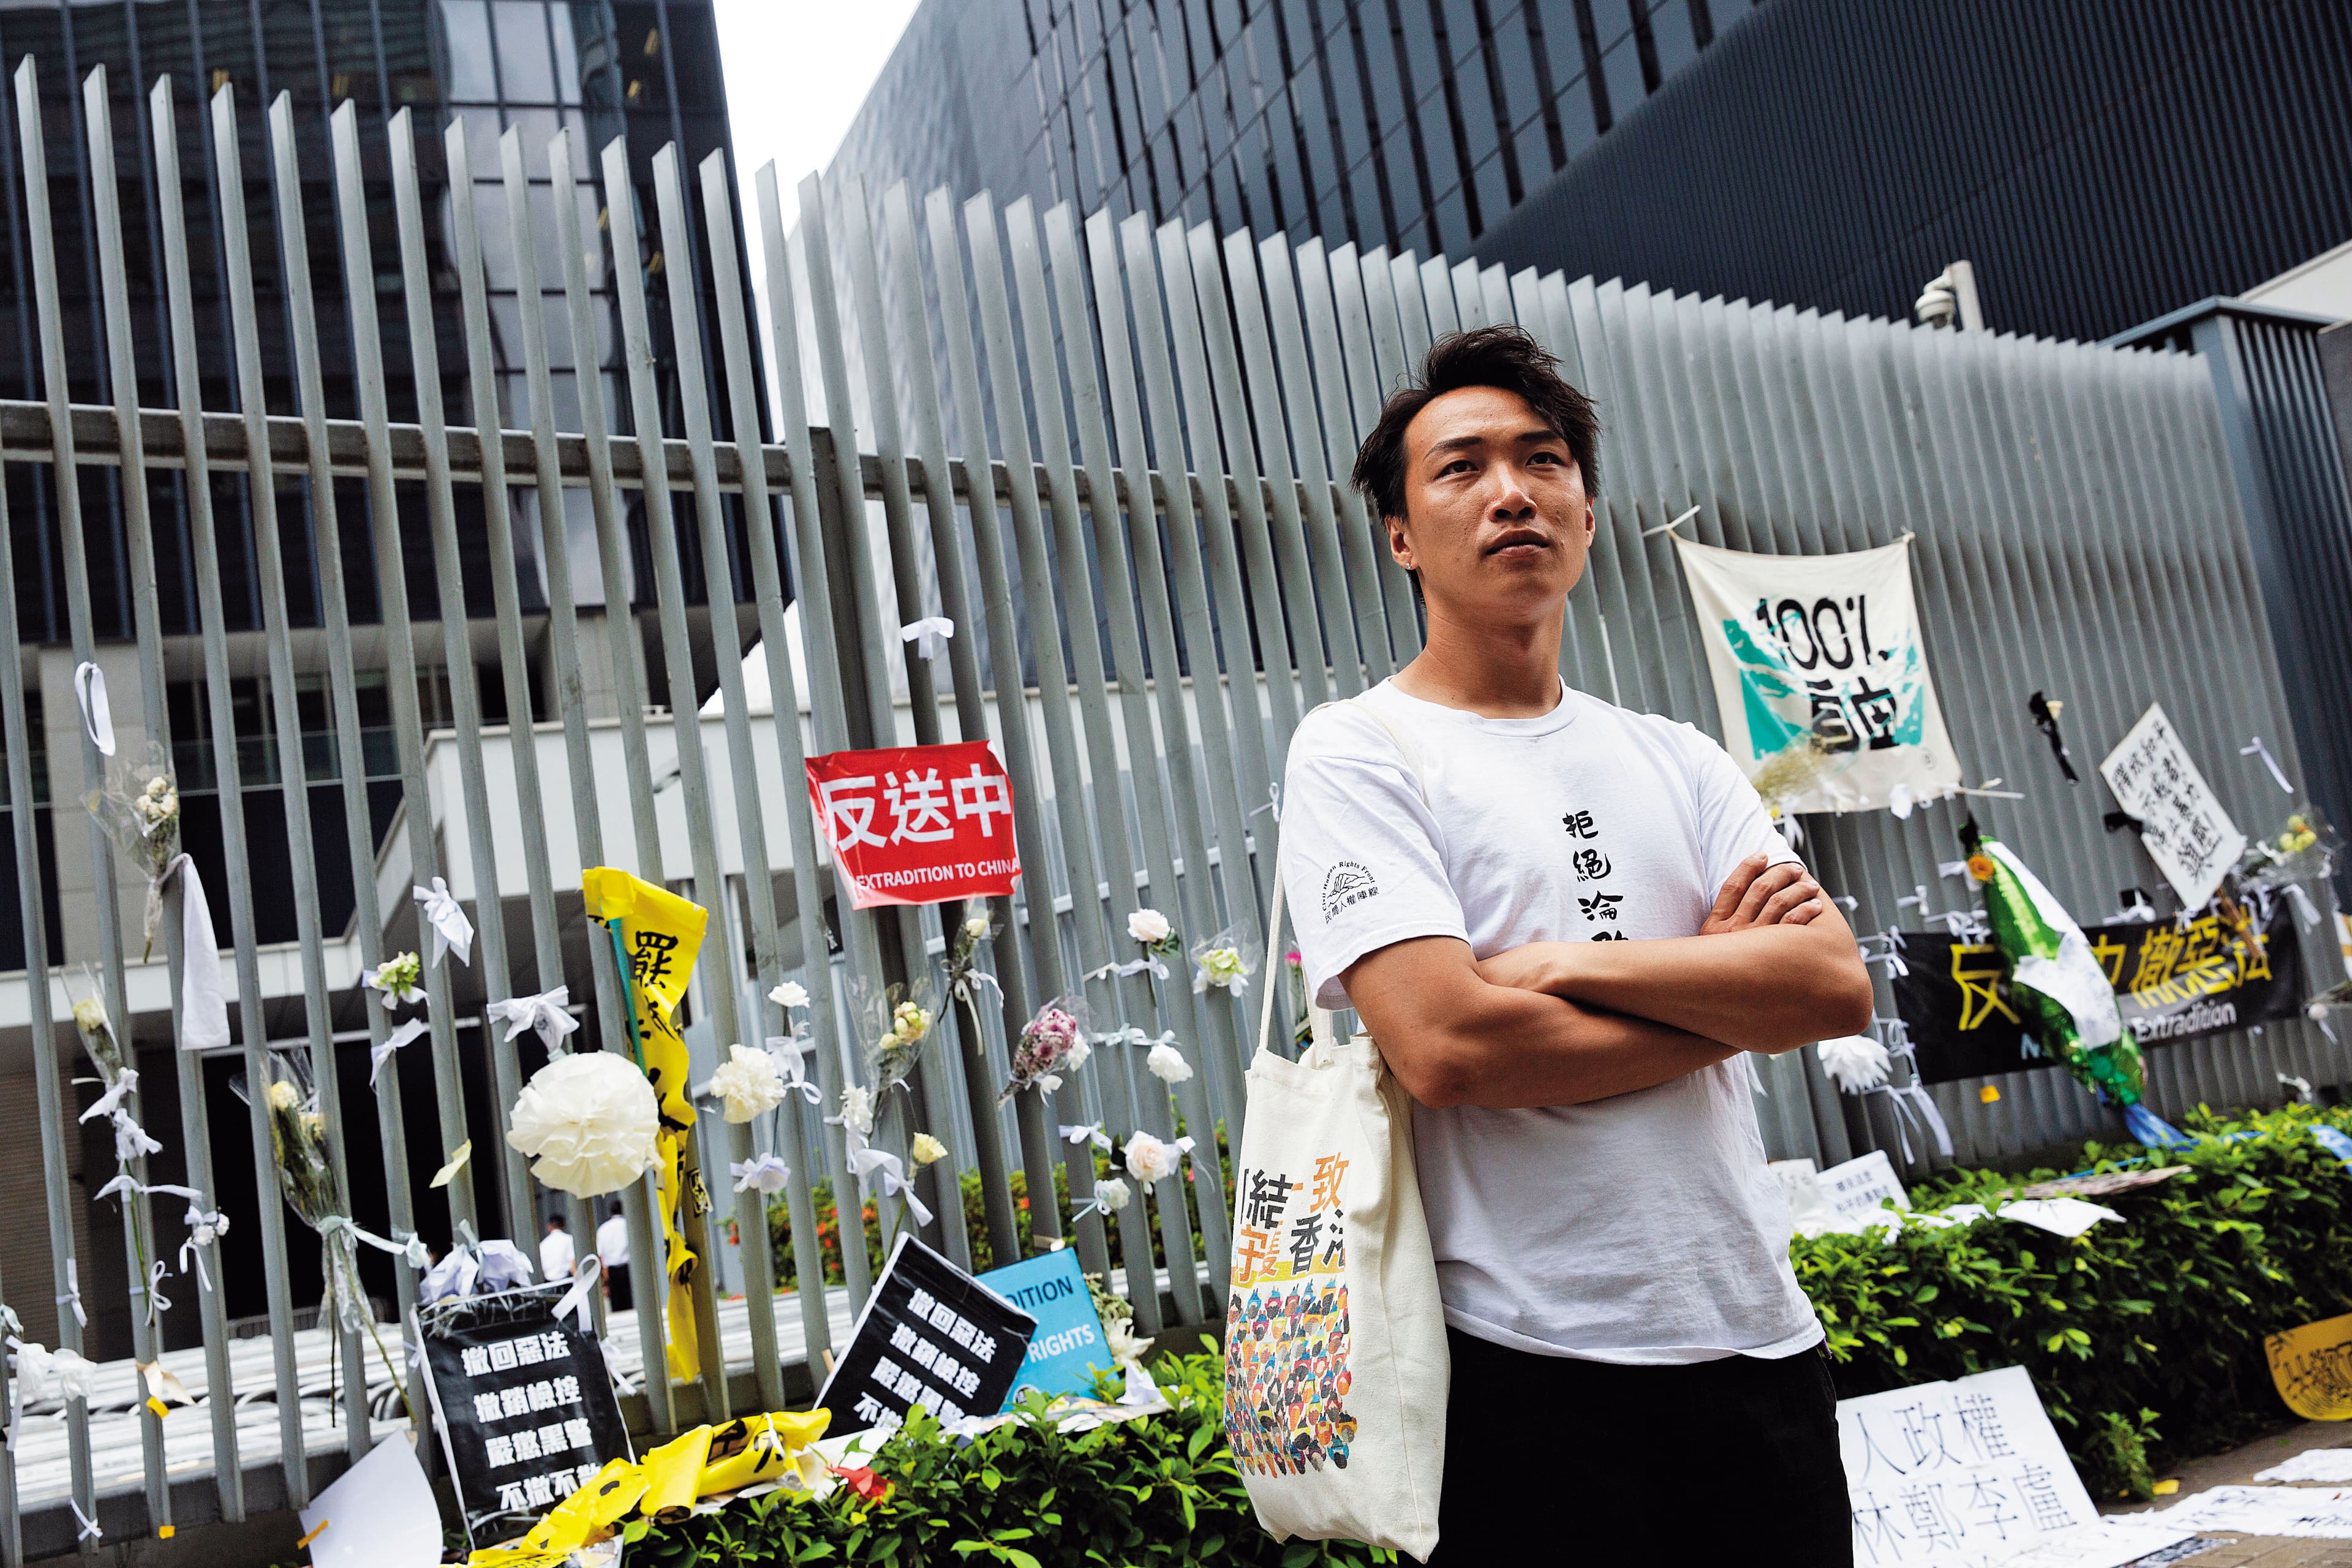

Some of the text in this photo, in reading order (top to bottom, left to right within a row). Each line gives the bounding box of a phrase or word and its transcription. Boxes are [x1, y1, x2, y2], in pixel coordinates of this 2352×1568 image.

[1756, 595, 1891, 670] 100%
[1806, 677, 1901, 754] 自由
[820, 763, 1012, 852] 反送中
[856, 858, 1020, 889] EXTRADITION TO CHINA
[1323, 865, 1336, 890] Human
[1339, 861, 1360, 869] Rights
[1361, 866, 1376, 883] Front
[1325, 886, 1380, 925] 民間人權陣線
[2132, 999, 2237, 1044] Extradition
[1241, 1152, 1350, 1229] 結致
[461, 1330, 571, 1378] 撤回惡法
[907, 1287, 997, 1364] 撤回惡法
[1027, 1324, 1095, 1363] RIGHTS
[870, 1355, 965, 1428] 嚴懲黑警
[889, 1322, 981, 1400] 撤銷檢控
[473, 1374, 582, 1423] 撤銷檢控
[484, 1417, 593, 1469] 嚴懲黑警
[1853, 1463, 2078, 1564] 林鄭李盧
